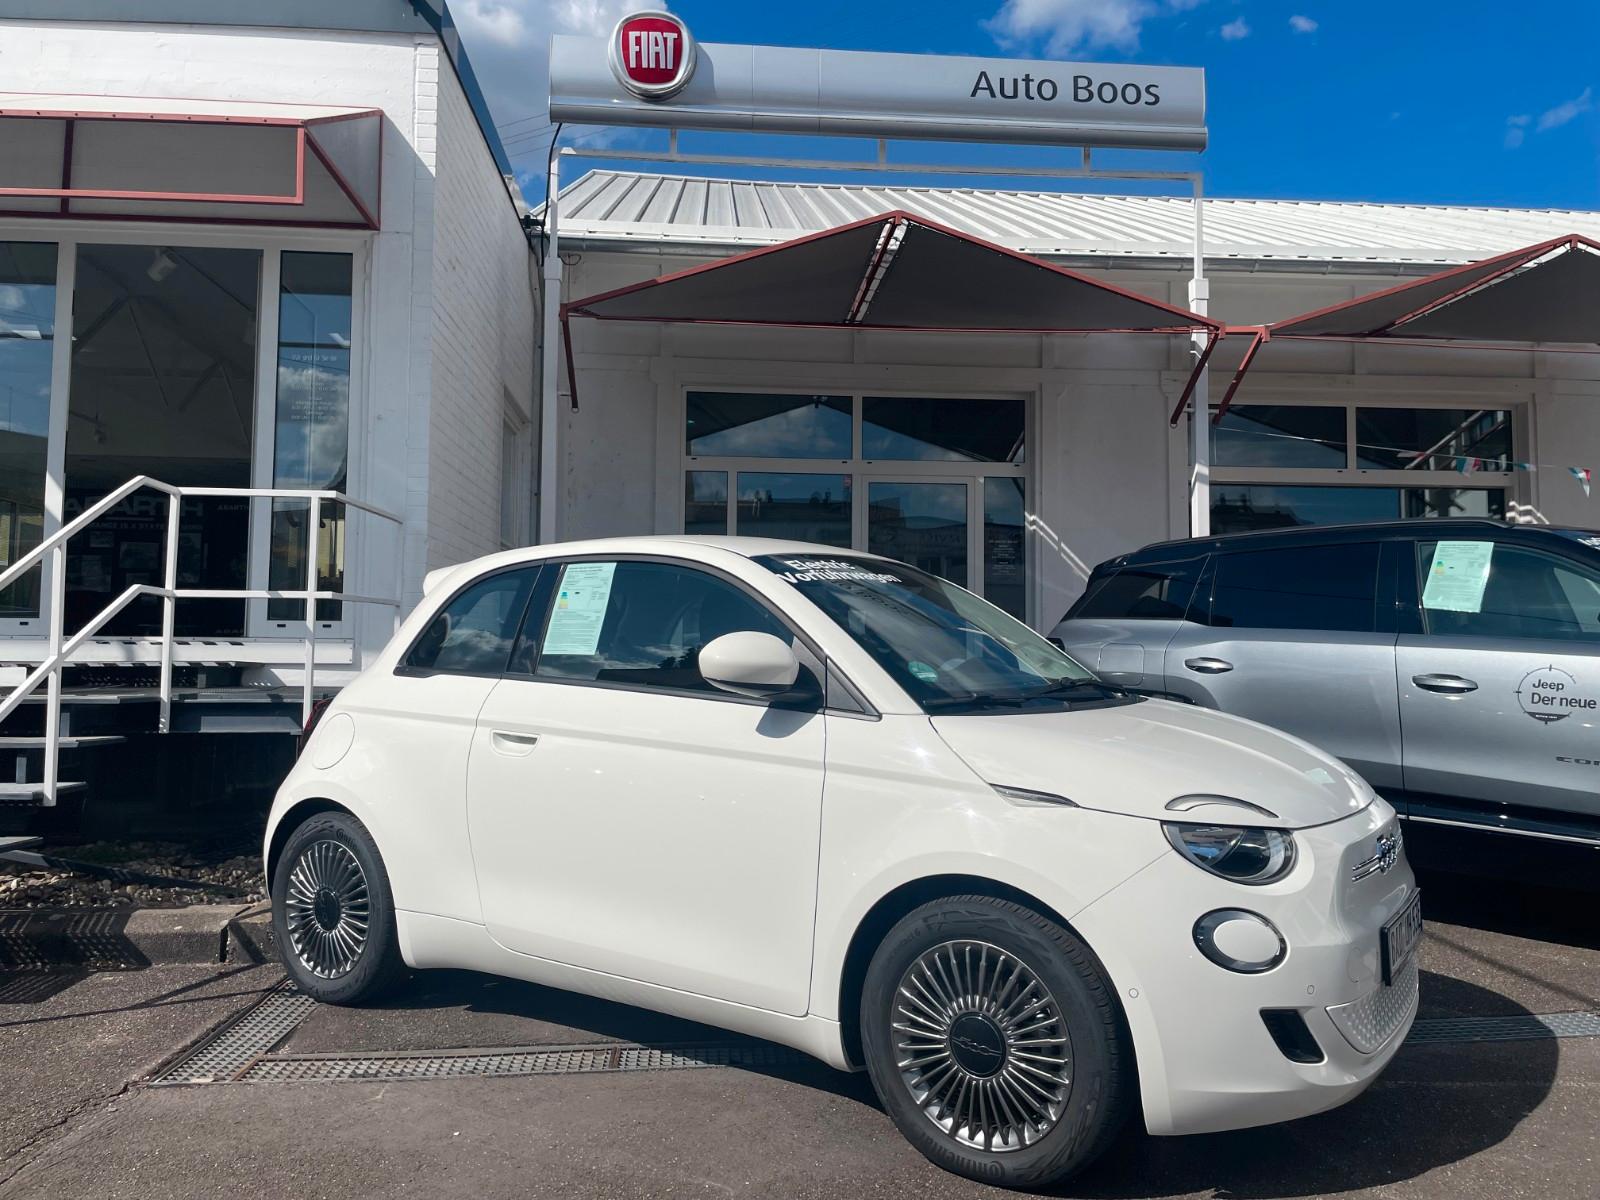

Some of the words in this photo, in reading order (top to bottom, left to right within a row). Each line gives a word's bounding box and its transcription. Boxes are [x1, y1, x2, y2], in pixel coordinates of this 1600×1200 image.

[628, 31, 678, 70] FIAT
[970, 71, 1058, 101] Auto
[1073, 75, 1160, 106] Boos
[1532, 679, 1565, 692] Jeep
[1531, 692, 1557, 706] Der
[1559, 696, 1597, 710] neue
